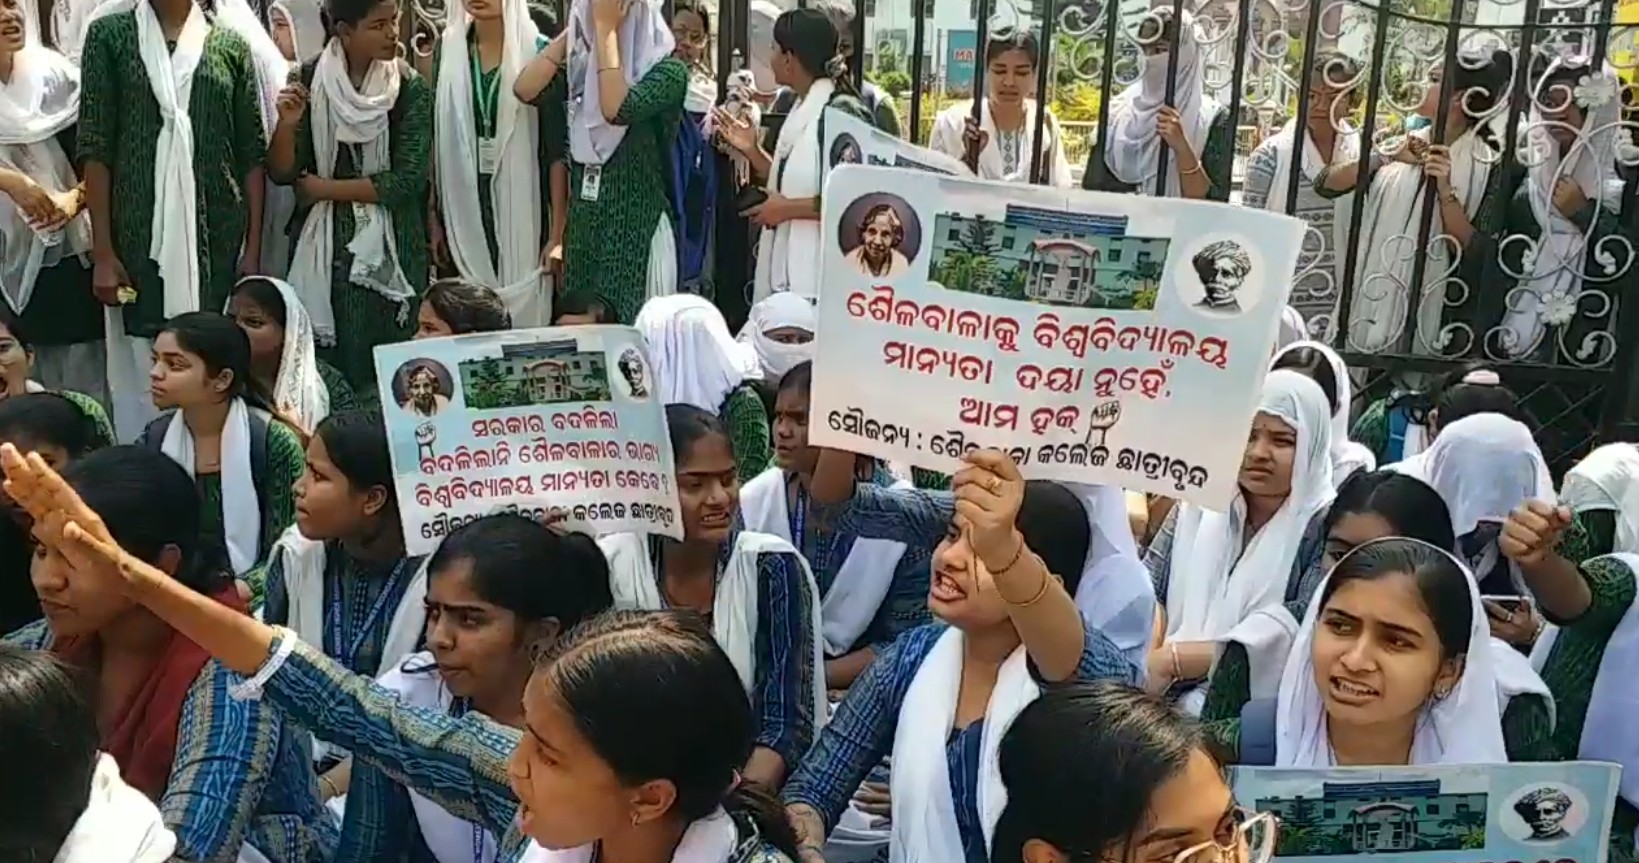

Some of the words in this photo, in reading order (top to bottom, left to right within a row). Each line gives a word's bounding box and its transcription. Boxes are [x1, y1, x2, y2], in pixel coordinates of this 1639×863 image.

[846, 286, 1020, 351] ଶୈଳବାଳାକୁ
[883, 341, 993, 384] ମାନ୍ୟତା
[1016, 364, 1084, 393] ଦୟା
[471, 414, 546, 437] ସରକାର
[551, 405, 619, 431] ବଦଳିଲା
[959, 397, 1019, 431] ଆମ
[1030, 405, 1080, 435] ହକ୍
[828, 406, 910, 449] ସୌଜନ୍ୟ
[1037, 443, 1110, 467] କଲେଜ
[420, 441, 512, 475] ବଦଳିଲାନି
[518, 437, 622, 463] ଶୈଳବାଳାର
[541, 470, 610, 491] ମାନ୍ୟତା
[573, 502, 626, 521] କଲେଜ
